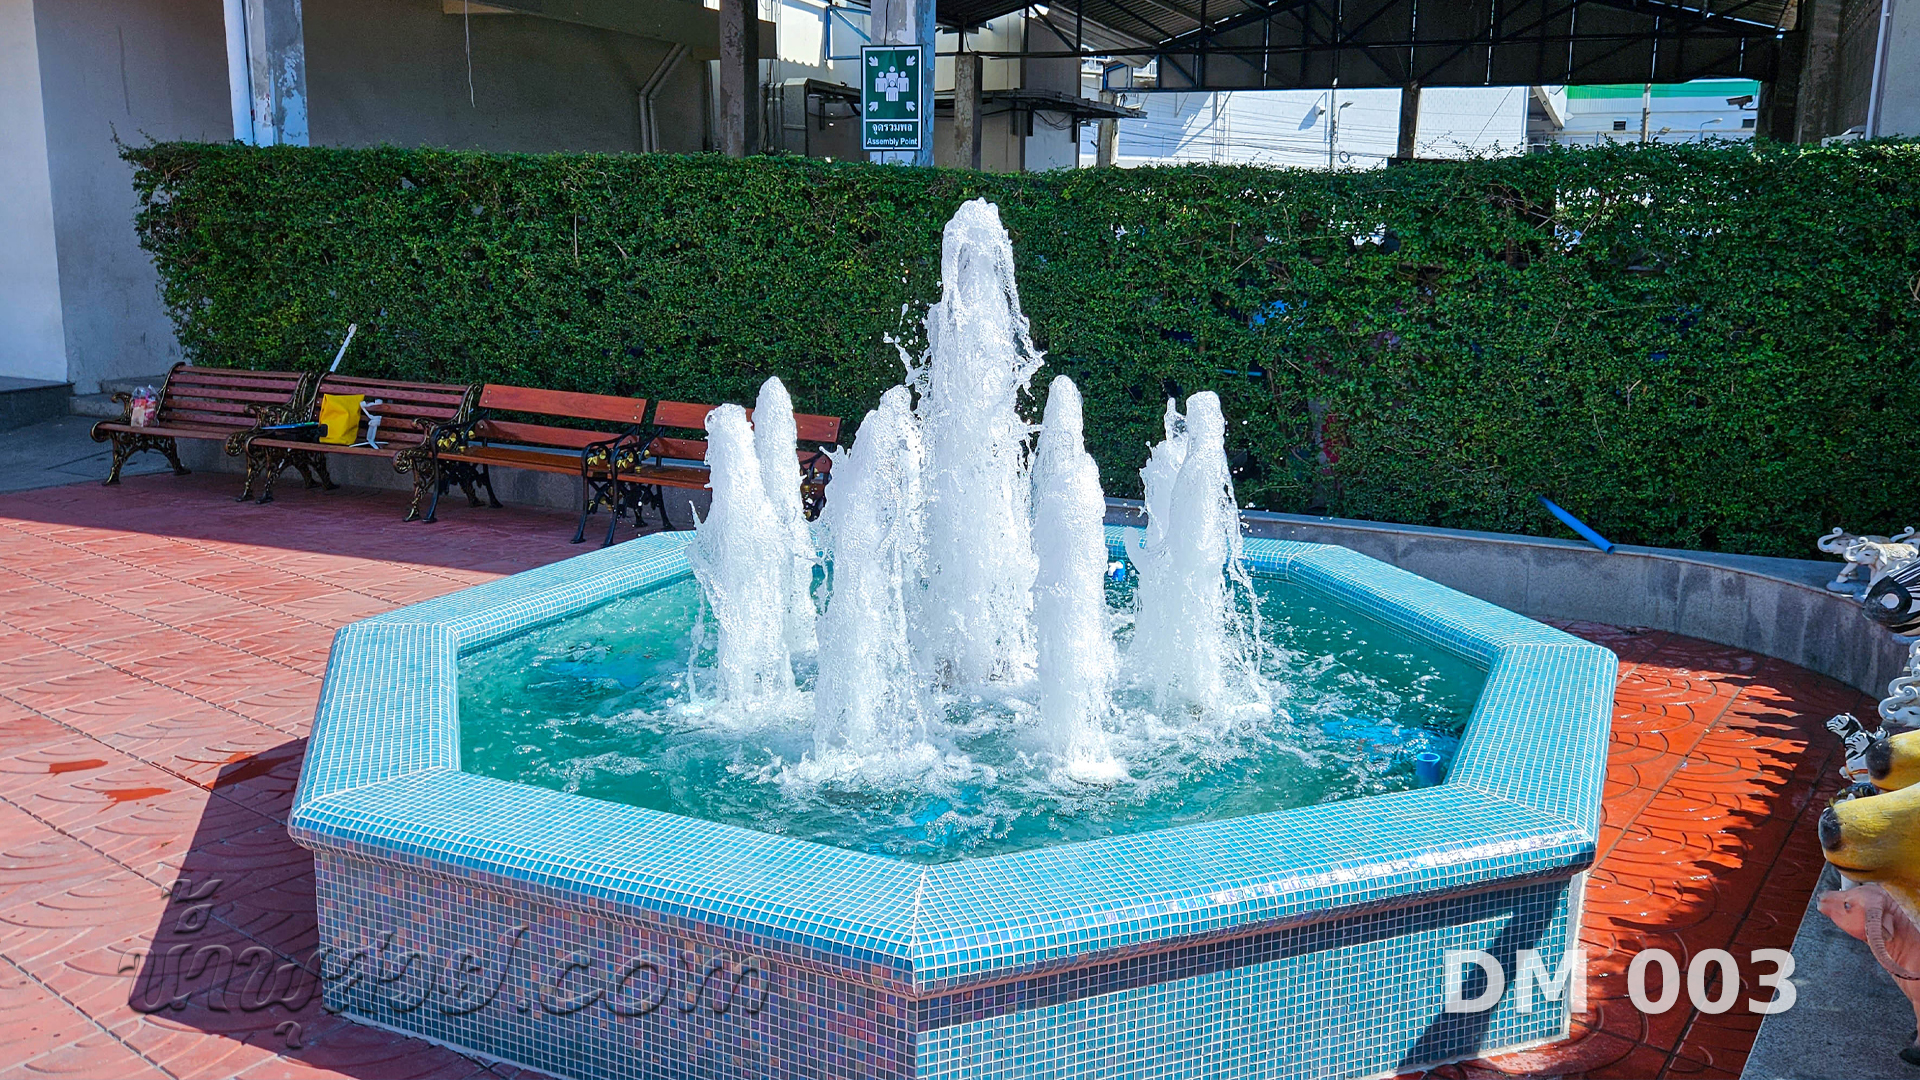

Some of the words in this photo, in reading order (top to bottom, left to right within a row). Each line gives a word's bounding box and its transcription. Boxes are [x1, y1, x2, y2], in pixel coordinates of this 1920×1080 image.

[872, 123, 913, 135] จุดรวมพล
[866, 137, 899, 147] Assembly
[900, 137, 918, 145] Point
